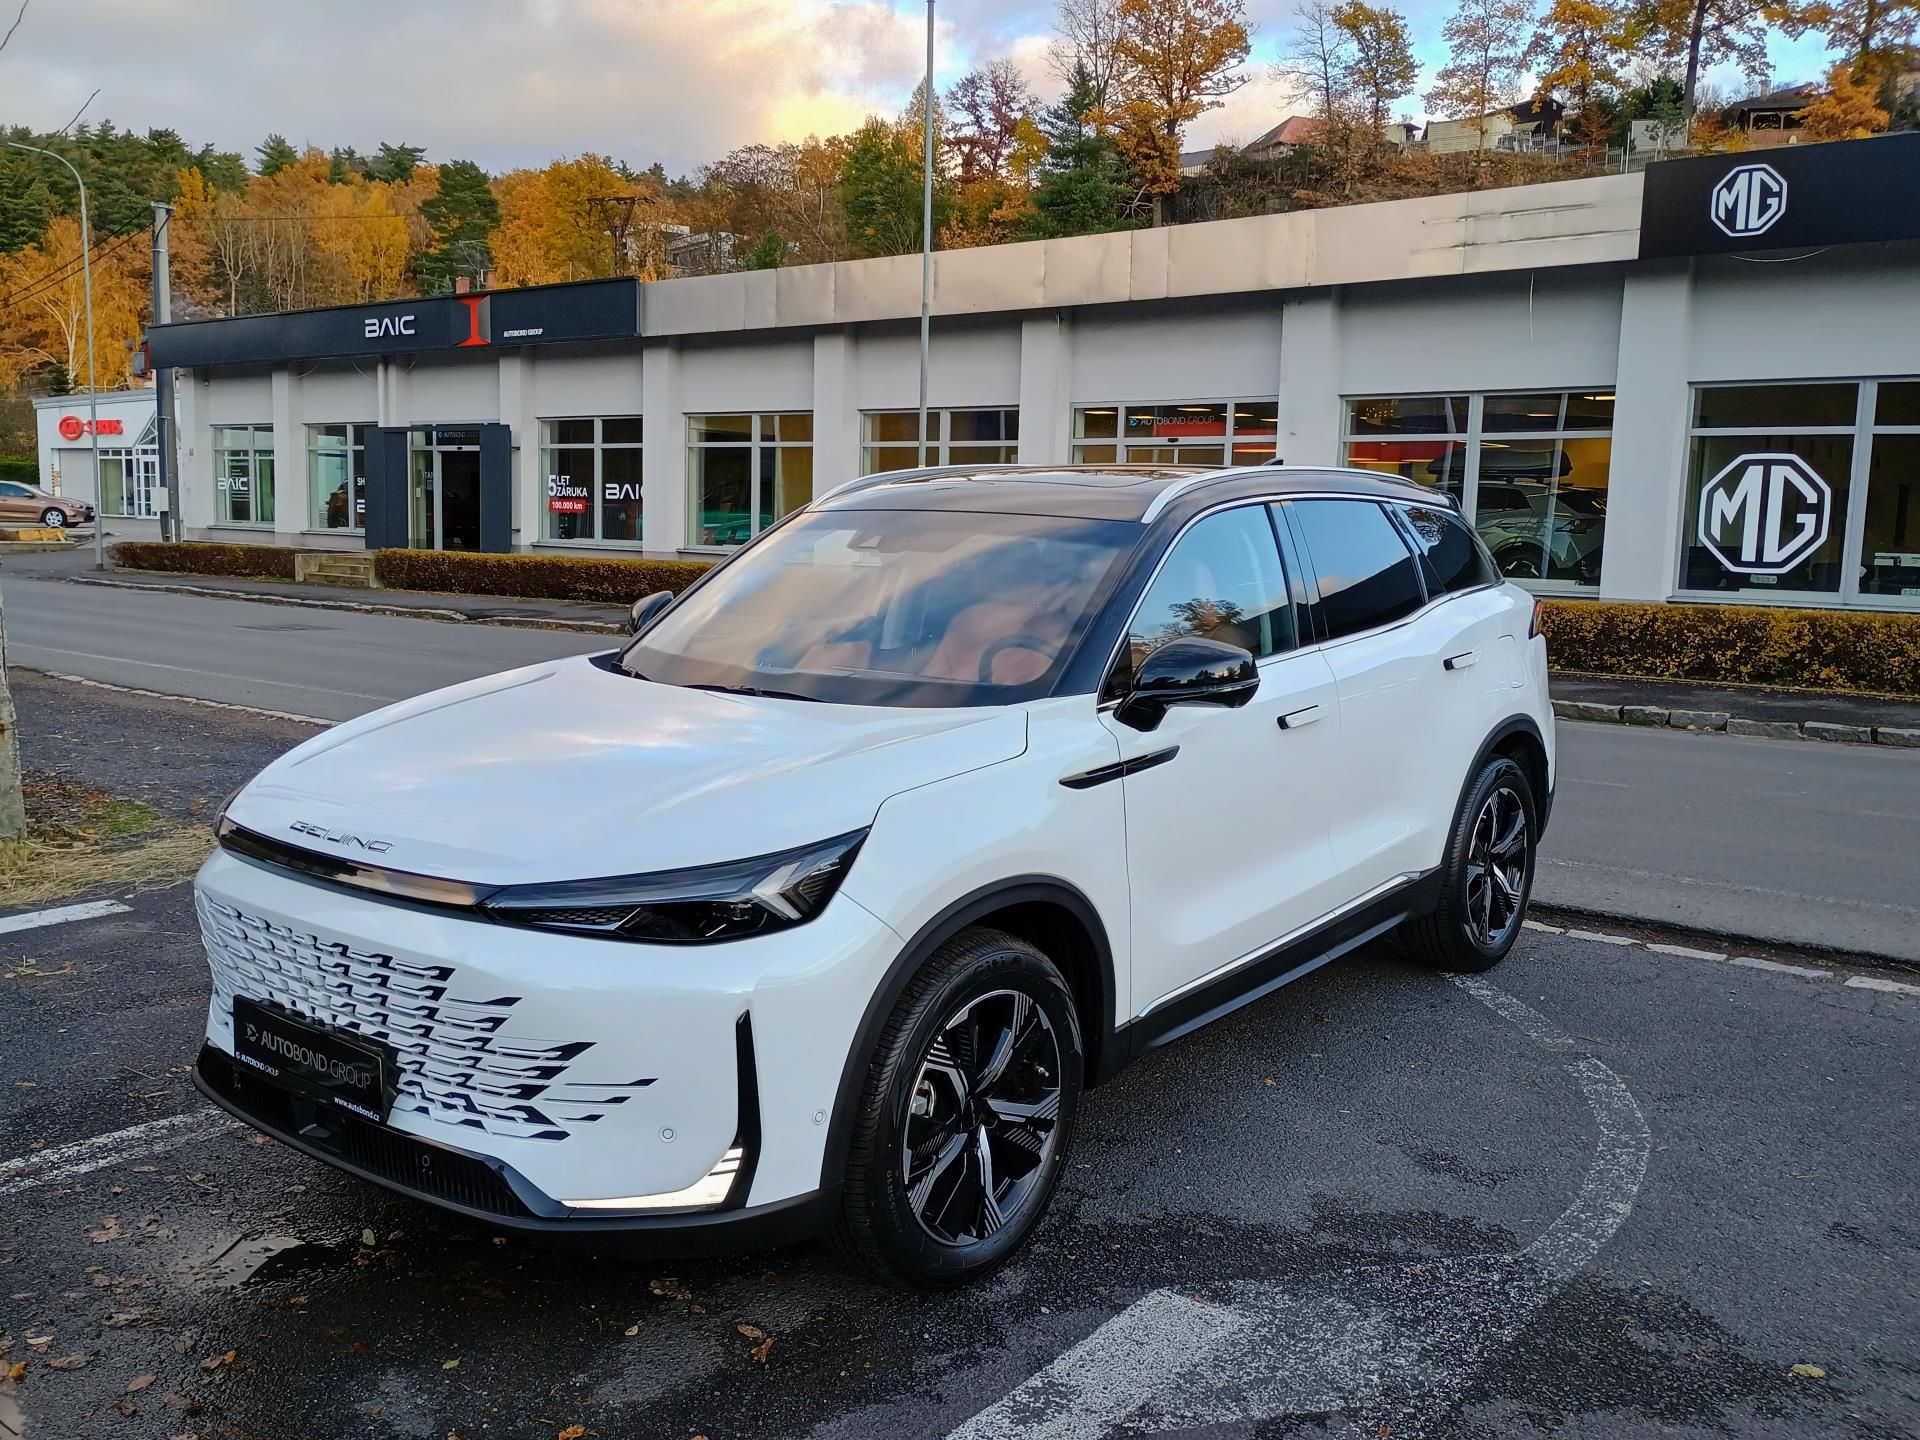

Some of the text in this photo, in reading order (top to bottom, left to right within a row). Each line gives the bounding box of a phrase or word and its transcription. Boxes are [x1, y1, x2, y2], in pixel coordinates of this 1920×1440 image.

[1717, 170, 1780, 231] MG
[364, 315, 415, 338] BAIC
[1140, 415, 1215, 426] AUTOBOND GROUP
[217, 477, 249, 491] BAIC
[547, 474, 571, 497] 5 LET
[556, 484, 588, 497] ZÁRUKA
[605, 483, 645, 500] BAI
[573, 501, 583, 510] km
[1710, 465, 1818, 563] MG
[288, 820, 395, 855] BEIJING
[260, 1030, 371, 1090] AUTOBOND GROUP
[333, 1096, 380, 1122] www.autobond.cz
